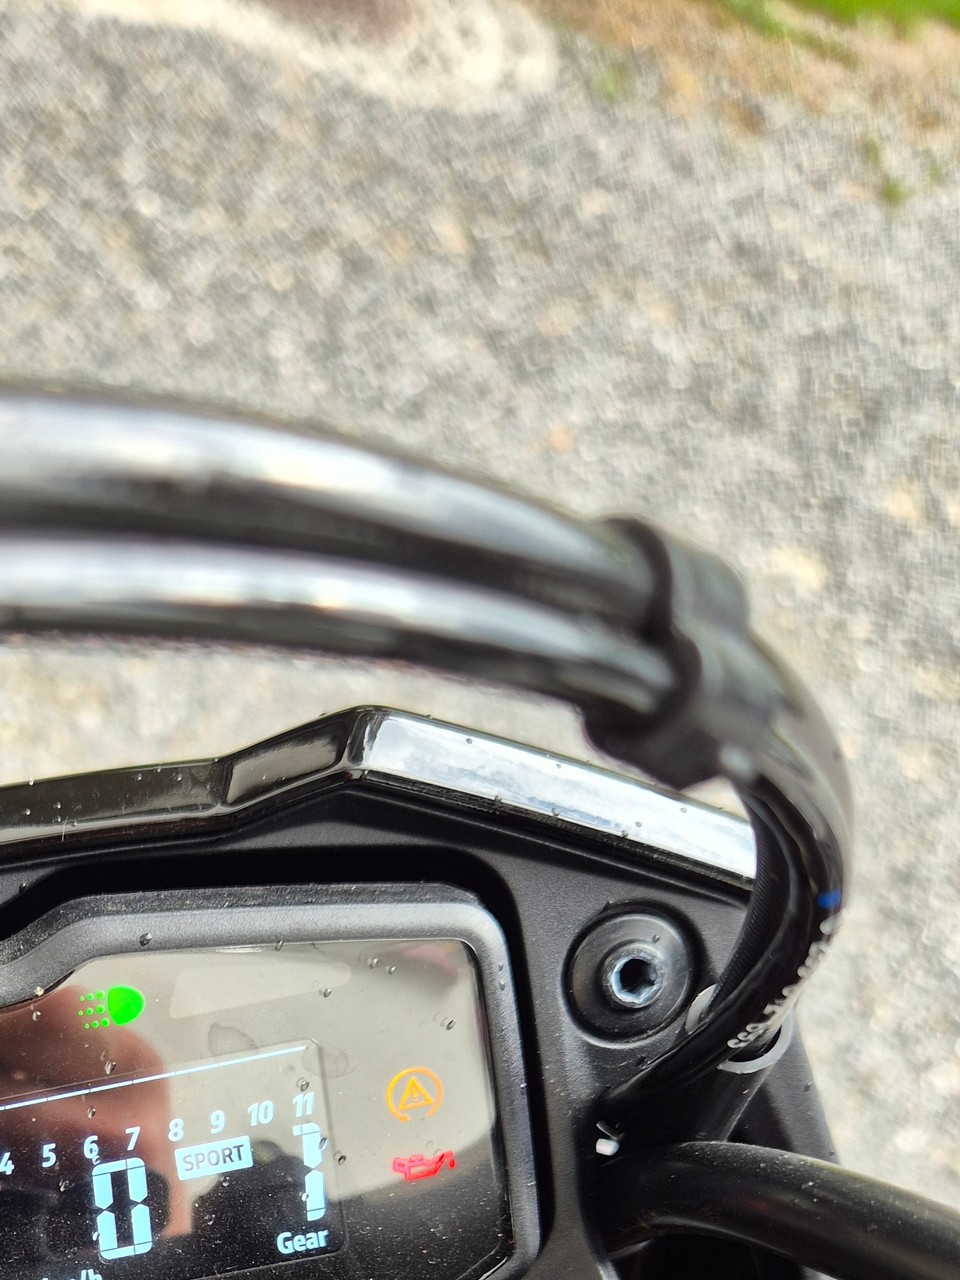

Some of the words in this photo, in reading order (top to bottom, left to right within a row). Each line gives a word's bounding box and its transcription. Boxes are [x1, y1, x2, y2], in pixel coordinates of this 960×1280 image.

[41, 1144, 57, 1168] 5
[83, 1136, 100, 1160] 6
[125, 1127, 141, 1151] 7
[168, 1119, 184, 1142] 8
[210, 1110, 226, 1134] 9
[247, 1101, 274, 1126] 10
[292, 1091, 315, 1118] 11
[182, 1144, 245, 1173] SPORT
[93, 1157, 153, 1260] 0
[276, 1229, 329, 1255] Gear
